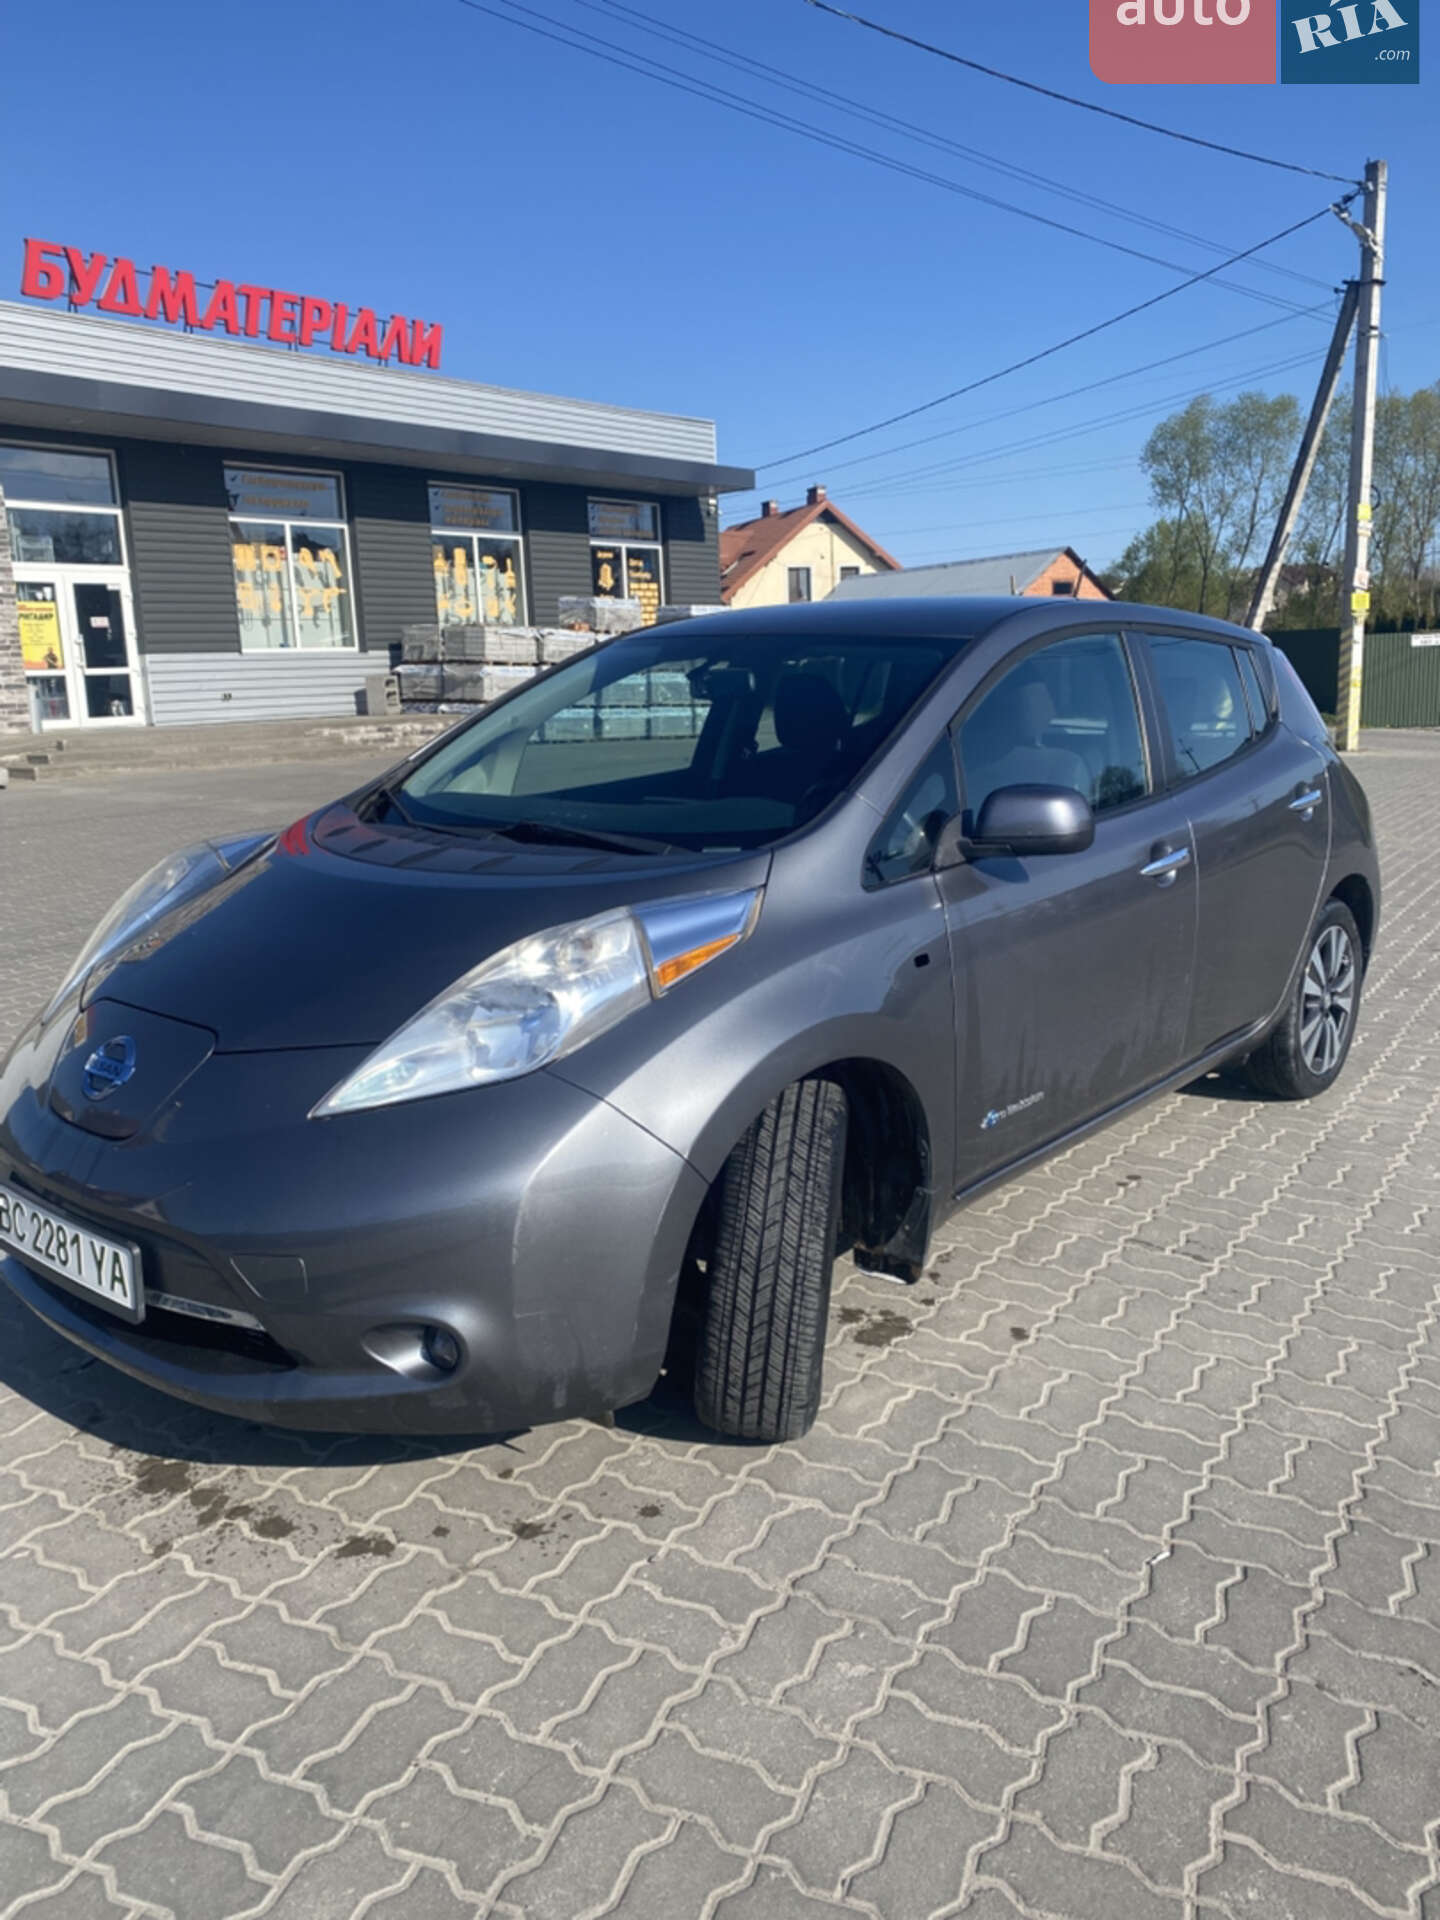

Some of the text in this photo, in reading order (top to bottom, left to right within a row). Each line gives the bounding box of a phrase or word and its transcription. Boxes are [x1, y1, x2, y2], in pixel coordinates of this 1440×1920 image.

[20, 237, 443, 370] БУДМАТЕРІАЛИ
[30, 1212, 83, 1275] 2281
[90, 1240, 128, 1298] YA
